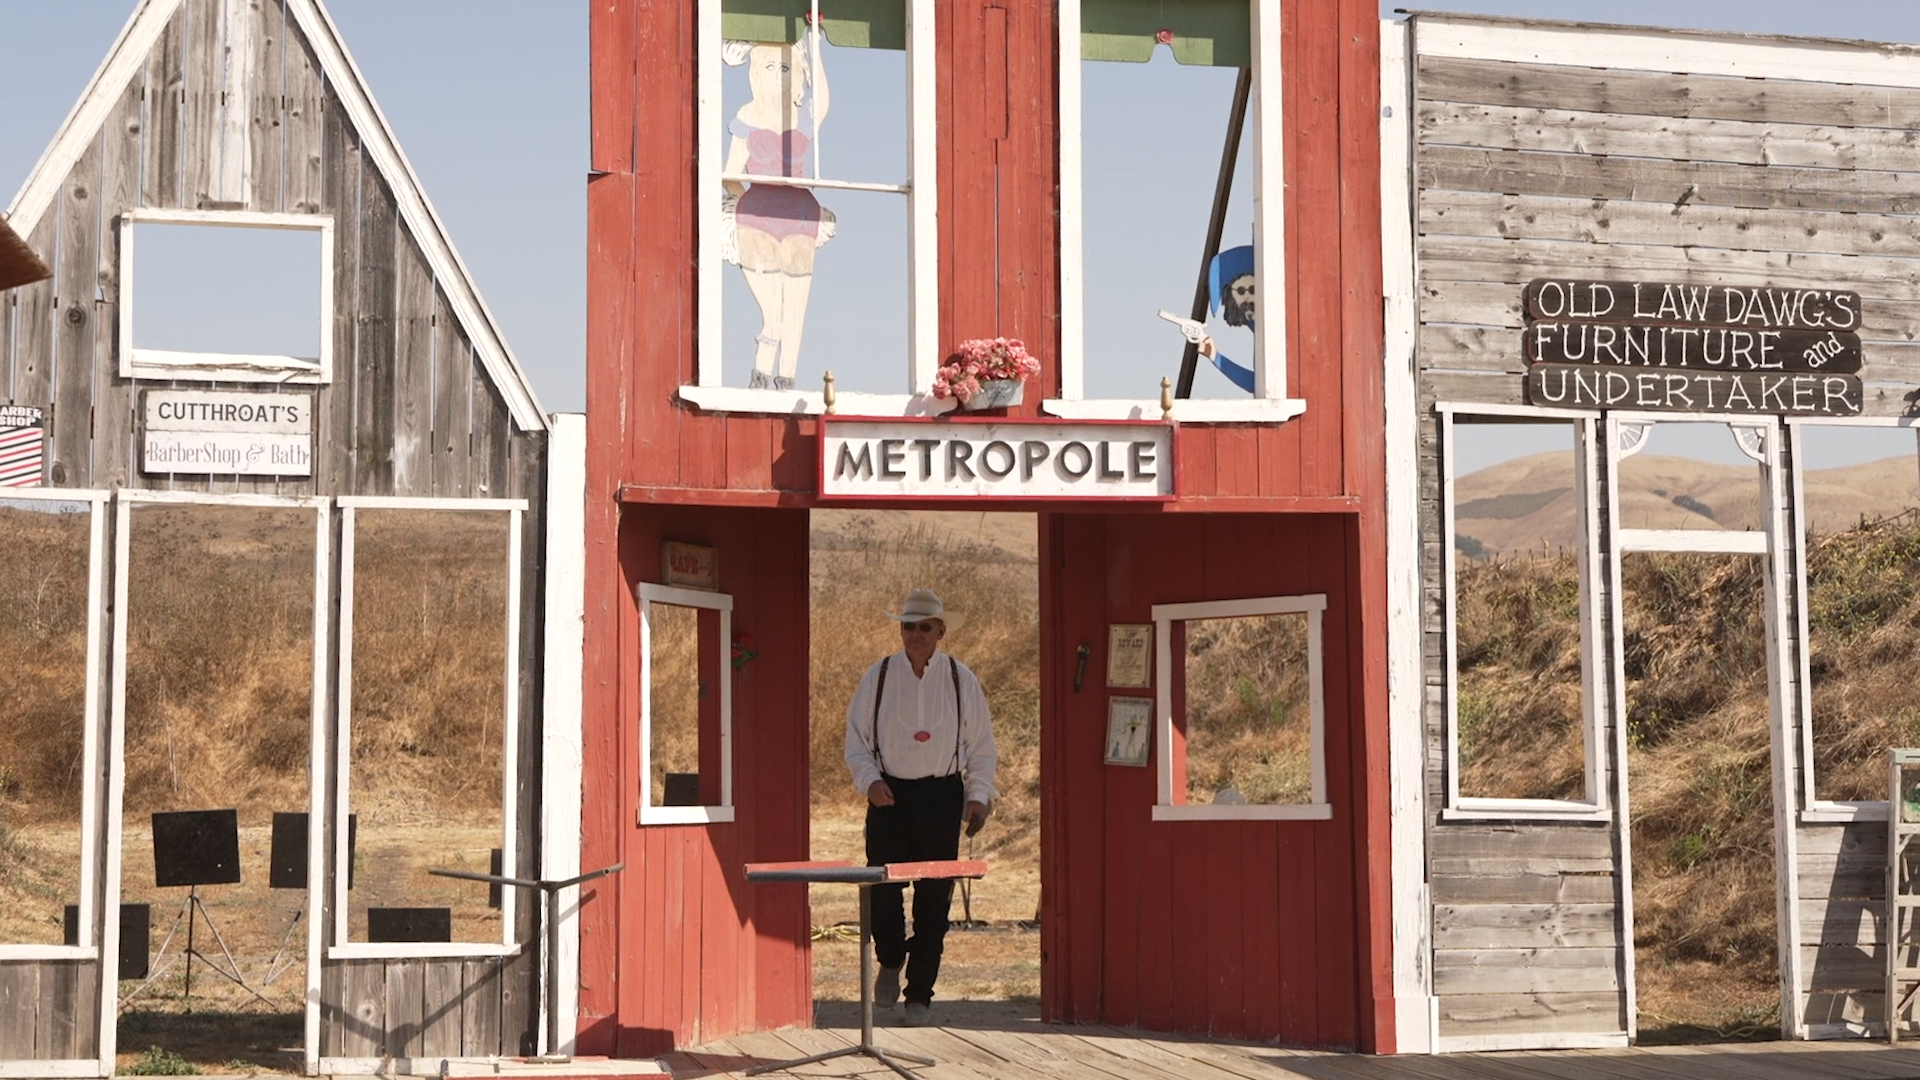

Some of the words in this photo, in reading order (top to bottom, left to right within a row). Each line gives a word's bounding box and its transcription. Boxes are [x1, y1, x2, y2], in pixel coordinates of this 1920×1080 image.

[1537, 281, 1615, 318] OLD
[1632, 282, 1713, 321] LAW
[1723, 287, 1855, 328] DAWG'S
[1535, 323, 1784, 370] FURNITURE
[1802, 331, 1845, 369] and
[1540, 369, 1859, 413] UNDERTAKER
[0, 416, 36, 427] SHOP
[158, 402, 299, 423] CUTTHROAT'S
[149, 441, 241, 468] BarberShop
[245, 443, 266, 463] &
[271, 444, 307, 465] Bath
[835, 439, 1157, 480] METROPOLE
